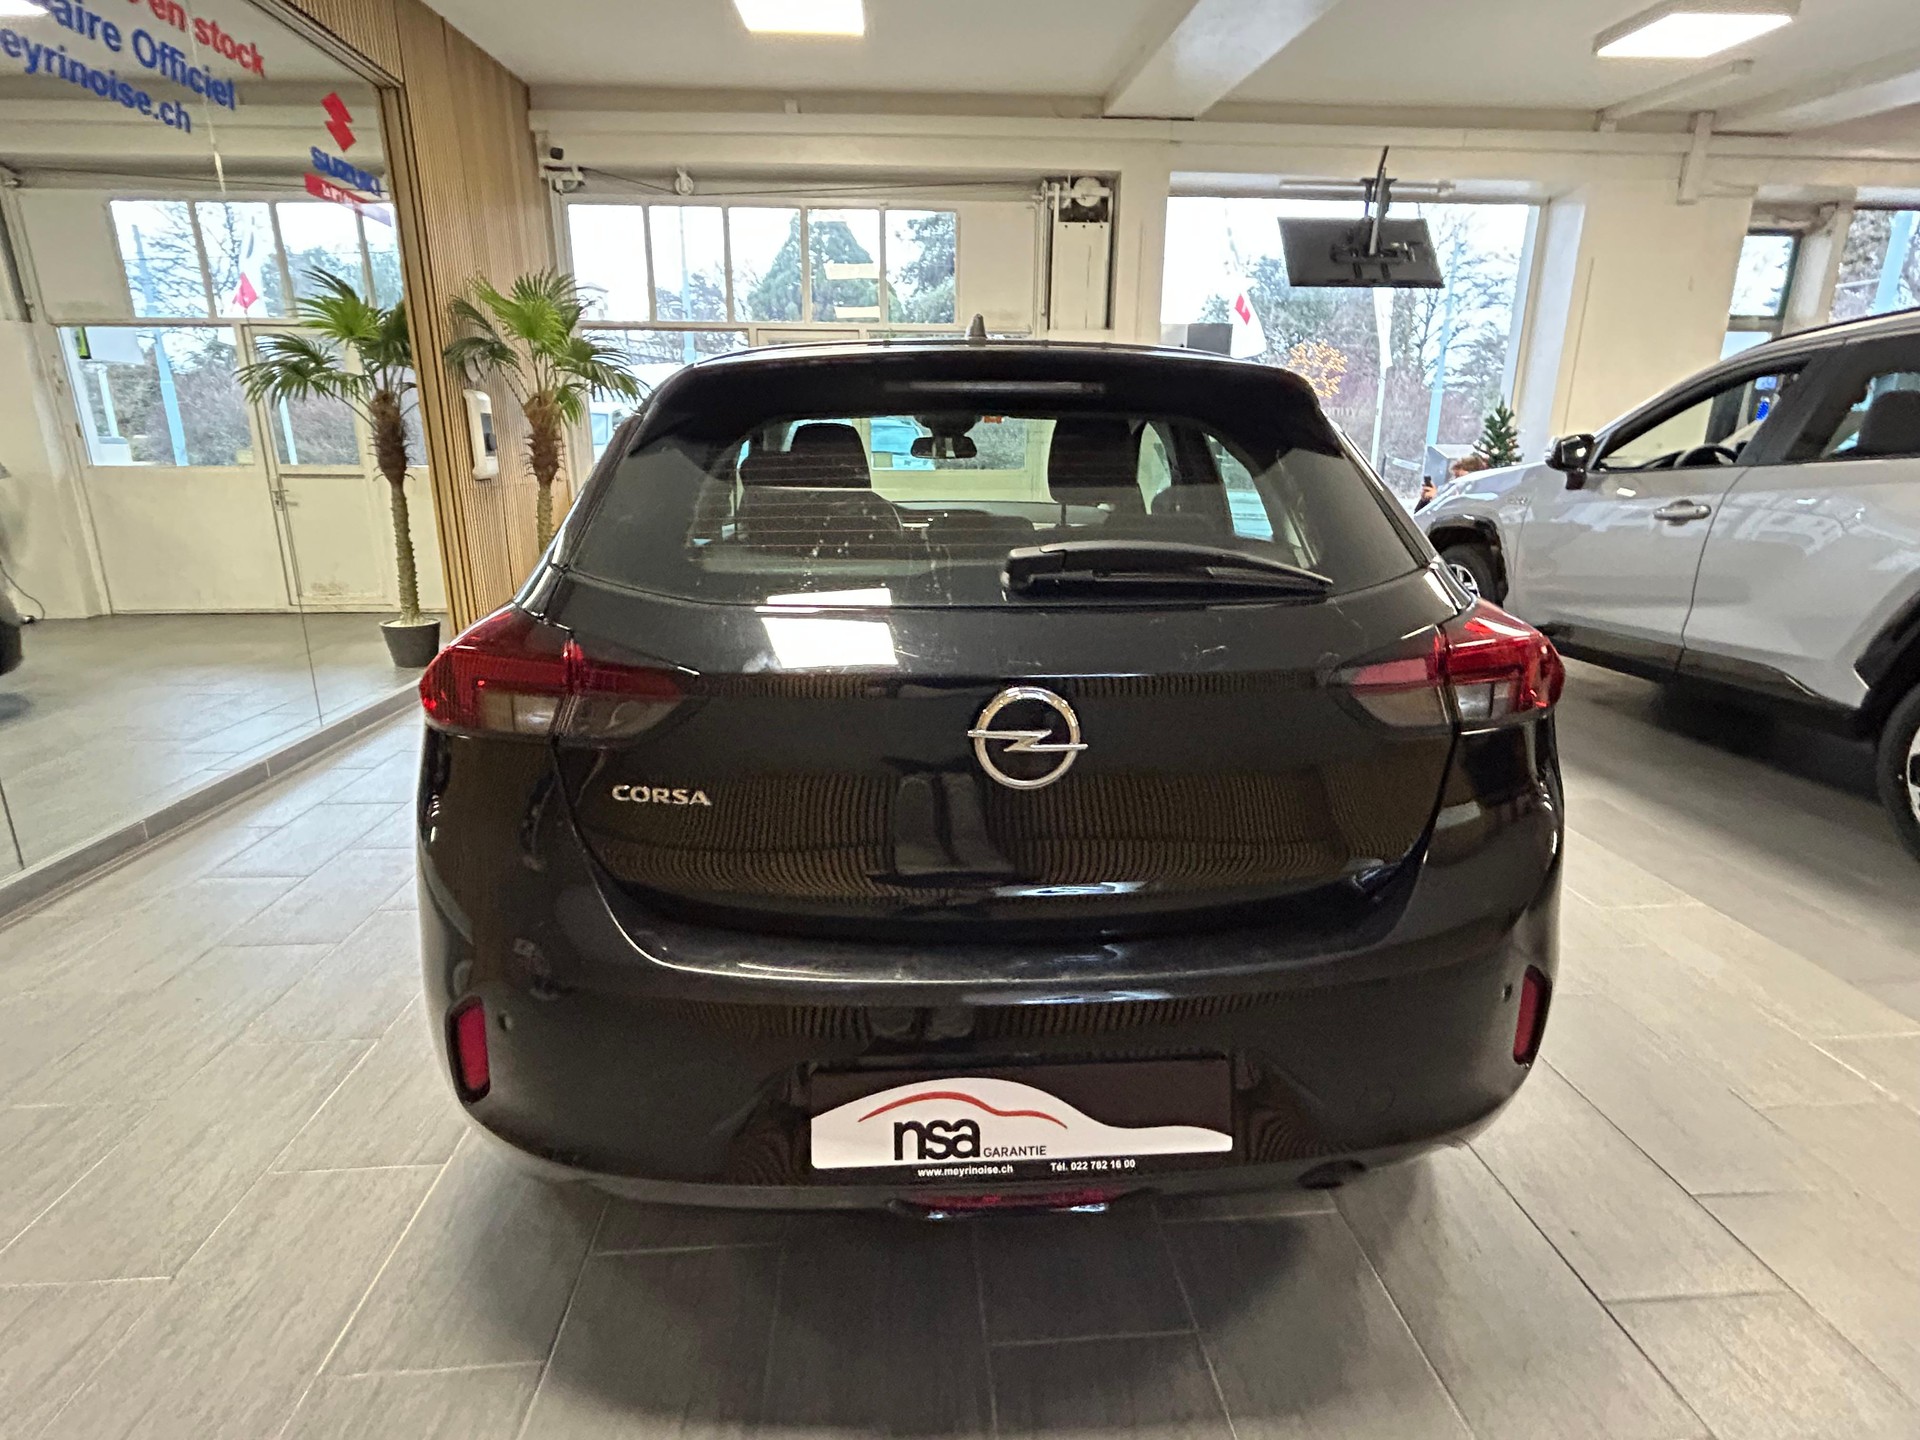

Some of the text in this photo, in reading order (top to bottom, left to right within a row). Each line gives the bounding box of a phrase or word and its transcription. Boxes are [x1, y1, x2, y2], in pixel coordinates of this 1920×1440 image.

[36, 0, 236, 111] aire Officiel
[150, 0, 265, 79] en stock
[0, 28, 191, 134] eyrinoise.ch
[611, 784, 712, 806] CORSA
[894, 1119, 1047, 1160] nsa GARANTIE
[917, 1164, 1014, 1177] www.meyrinoise.ch
[1070, 1161, 1088, 1171] 022
[1123, 1158, 1136, 1169] 00
